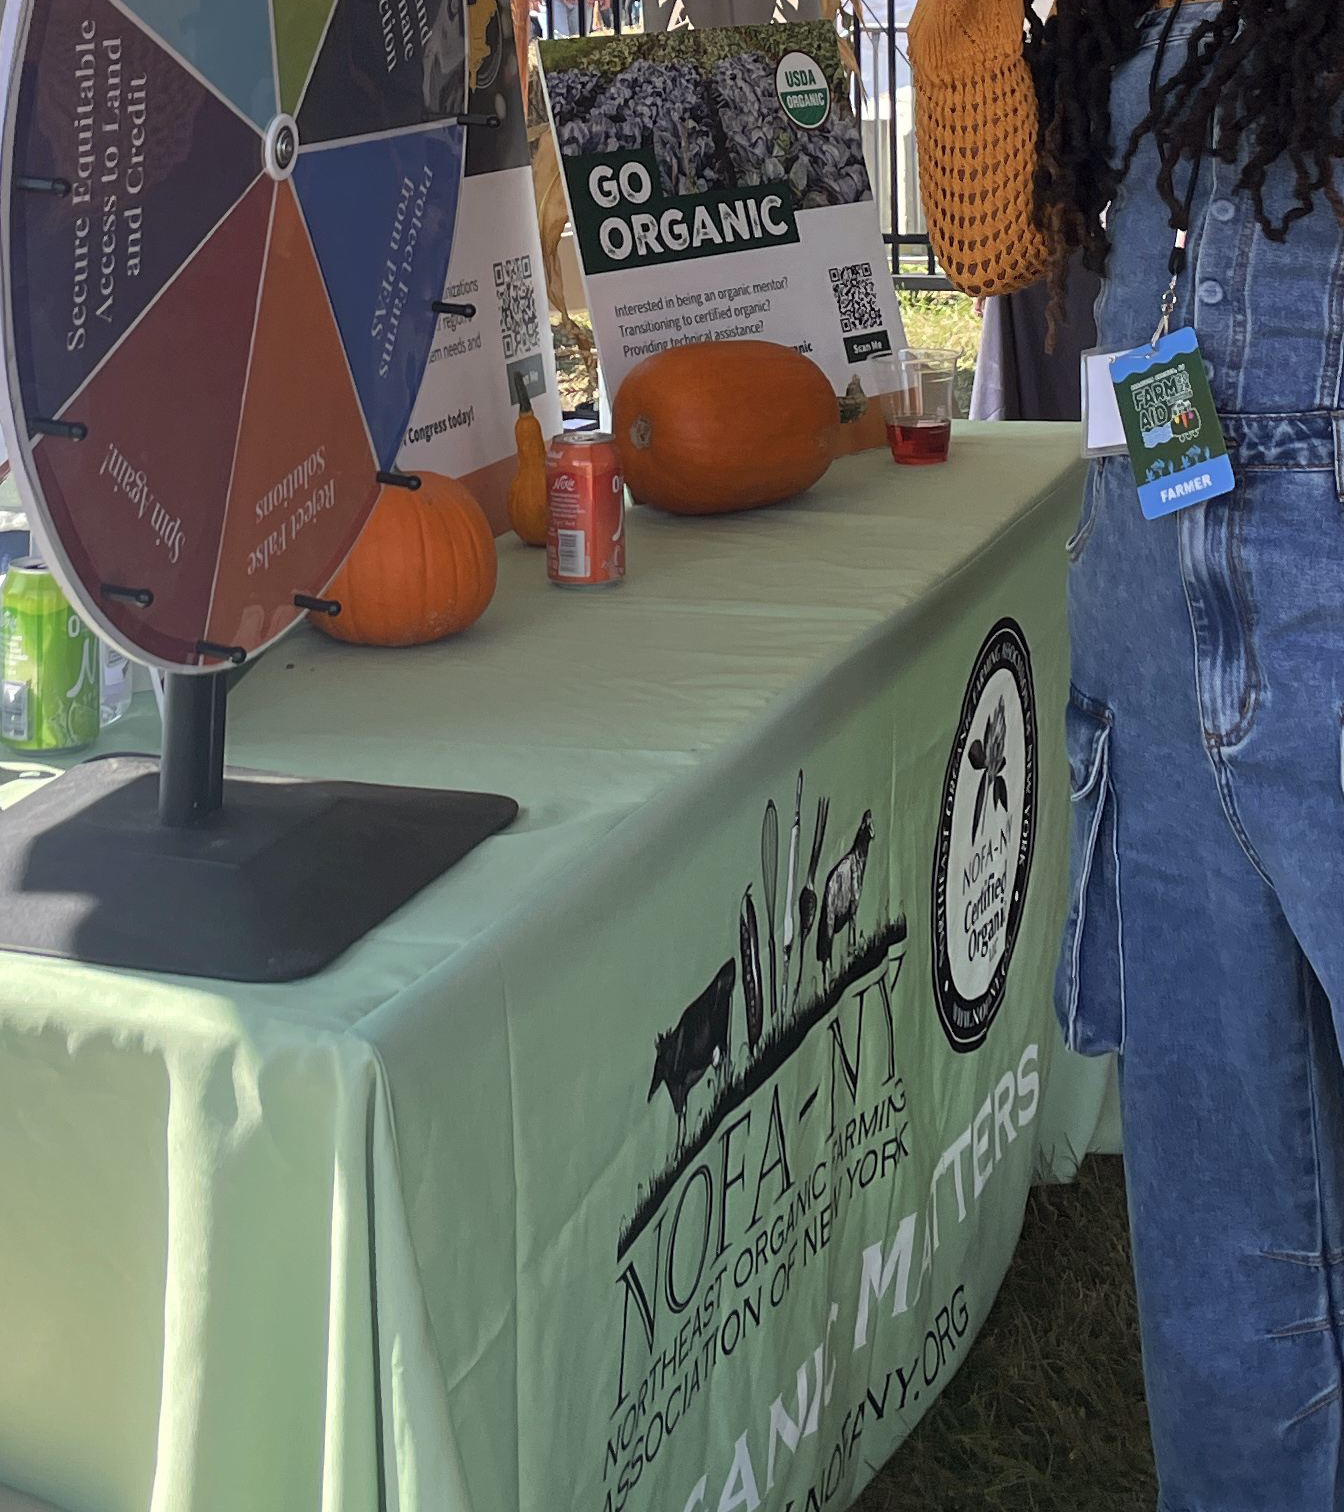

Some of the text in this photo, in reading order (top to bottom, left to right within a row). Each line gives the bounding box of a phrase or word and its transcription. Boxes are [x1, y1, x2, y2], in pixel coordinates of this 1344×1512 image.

[784, 68, 817, 88] USDA
[785, 91, 825, 110] ORGANIC
[67, 19, 96, 352] Secure Equitable
[95, 36, 122, 323] Access to Land
[124, 71, 147, 277] and Credit
[588, 160, 652, 208] GO
[389, 176, 415, 251] from
[599, 194, 789, 261] ORGANIC
[379, 165, 434, 379] Protect Farms
[615, 276, 789, 318] Interested in being an organic mentor?
[443, 341, 467, 359] needs
[467, 331, 482, 352] and
[619, 299, 771, 339] Transitioning to certified organic?
[623, 320, 764, 358] Providing technical assistance?
[408, 405, 475, 445] Congress today!
[1132, 374, 1178, 411] FARM
[1139, 402, 1168, 432] AID
[100, 442, 186, 564] Spin Again!
[255, 444, 326, 524] Solutions
[1159, 473, 1213, 504] FARMER
[247, 478, 336, 575] Reject False
[964, 859, 1008, 935] Certified
[968, 896, 1006, 962] Organi
[852, 1042, 1041, 1353] MATTERS
[600, 1296, 764, 1511] ASSOCIATION
[768, 1245, 796, 1308] OF
[845, 1121, 910, 1189] YORK
[602, 1269, 727, 1482] NORTHEAST
[733, 1162, 829, 1291] ORGANIC
